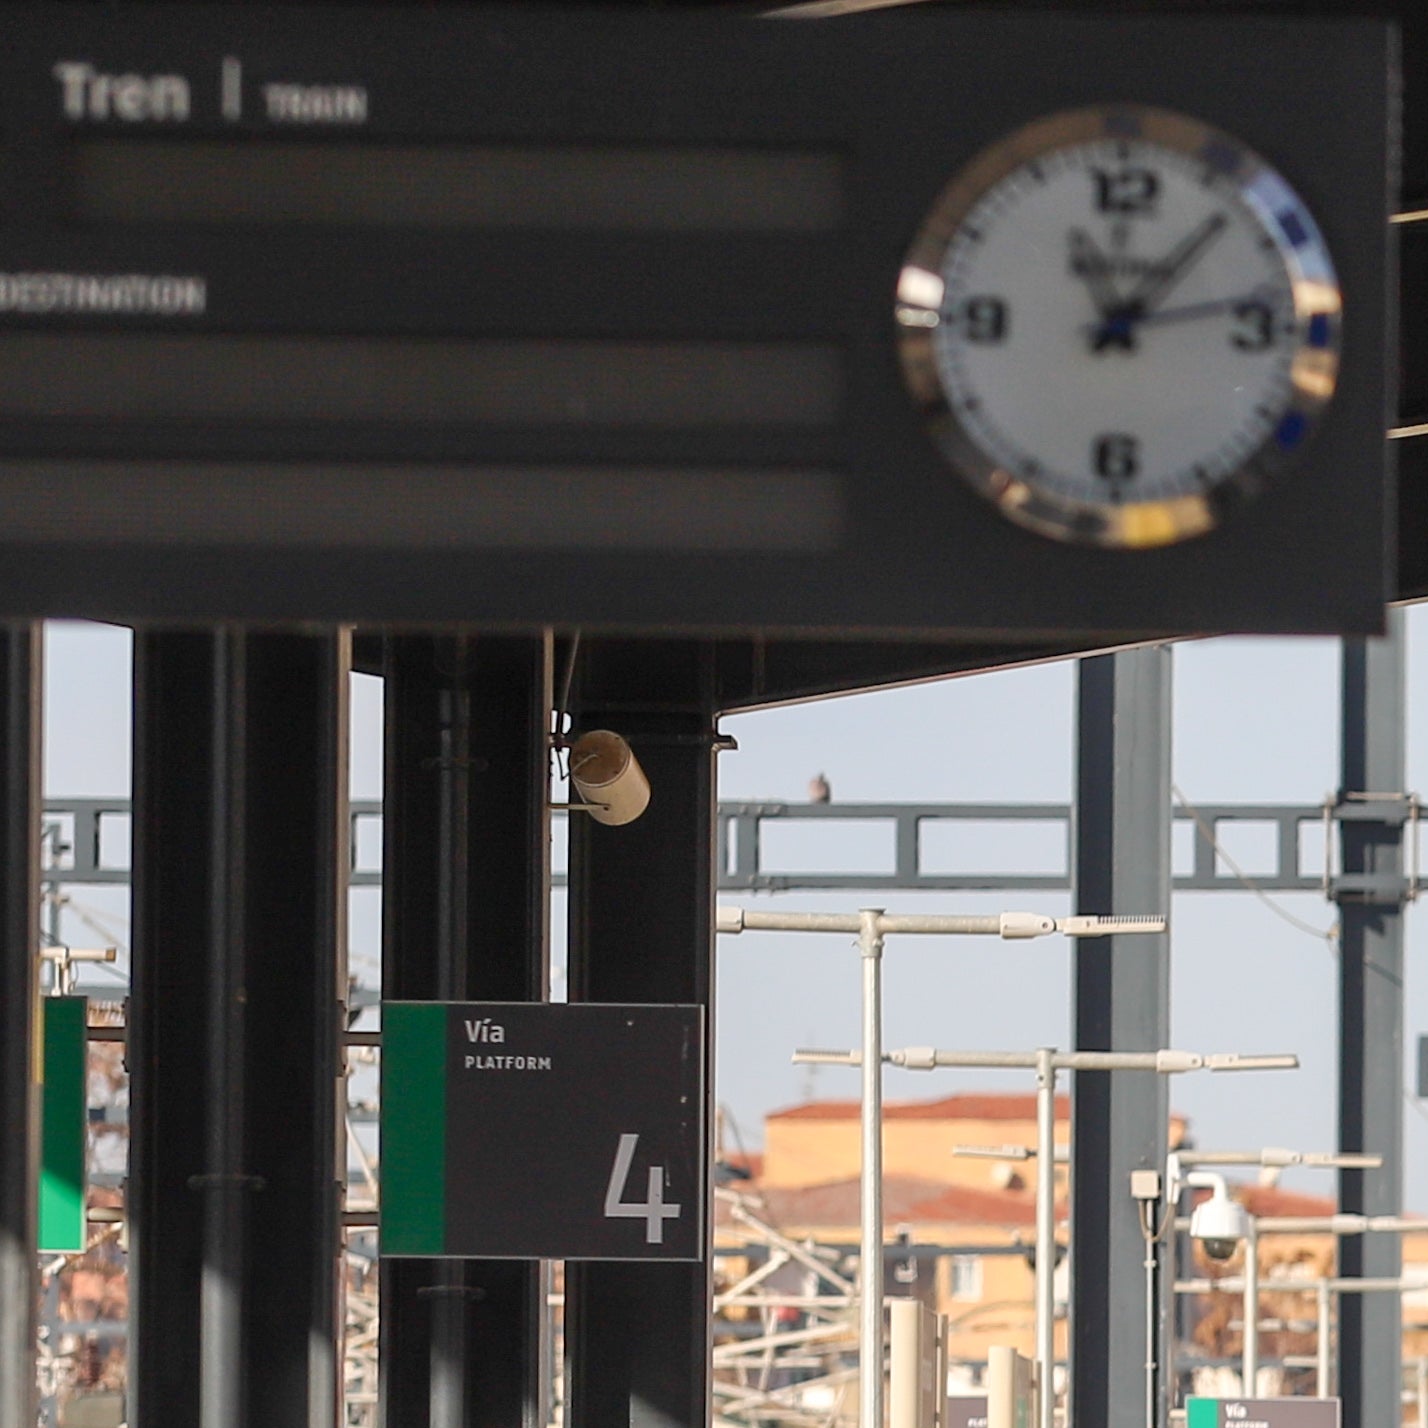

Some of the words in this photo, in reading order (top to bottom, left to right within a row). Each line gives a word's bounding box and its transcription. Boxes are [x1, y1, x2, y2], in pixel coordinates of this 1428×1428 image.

[53, 61, 191, 121] Tren
[1093, 167, 1159, 214] 12
[965, 296, 1009, 345] 9
[1230, 301, 1273, 352] 3
[1093, 434, 1139, 480] 6
[464, 1018, 505, 1043] Vía
[464, 1055, 552, 1070] PLATFORM
[604, 1133, 681, 1243] 4
